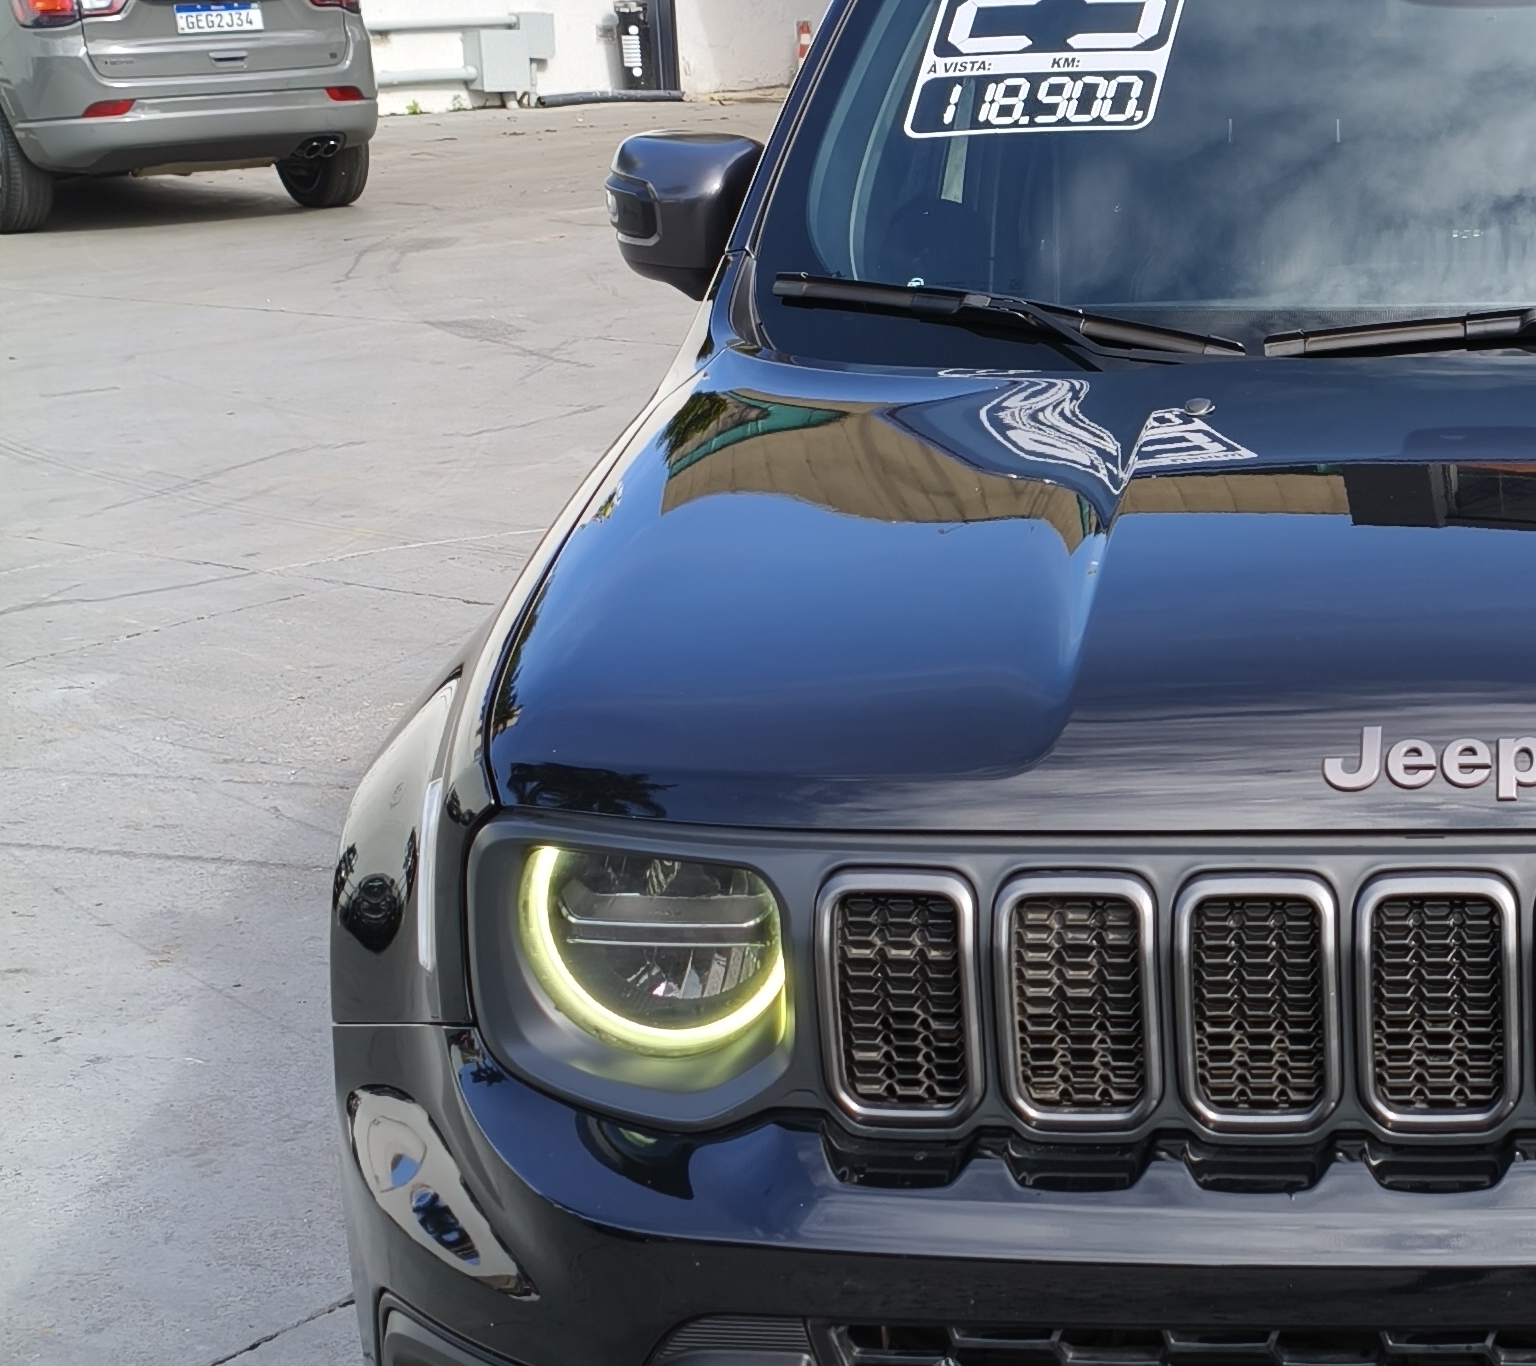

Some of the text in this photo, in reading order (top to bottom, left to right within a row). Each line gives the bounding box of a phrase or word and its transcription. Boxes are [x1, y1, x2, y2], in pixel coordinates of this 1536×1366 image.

[185, 12, 254, 30] GEG2J34
[943, 61, 992, 73] VISTA:
[1050, 57, 1081, 69] KM:
